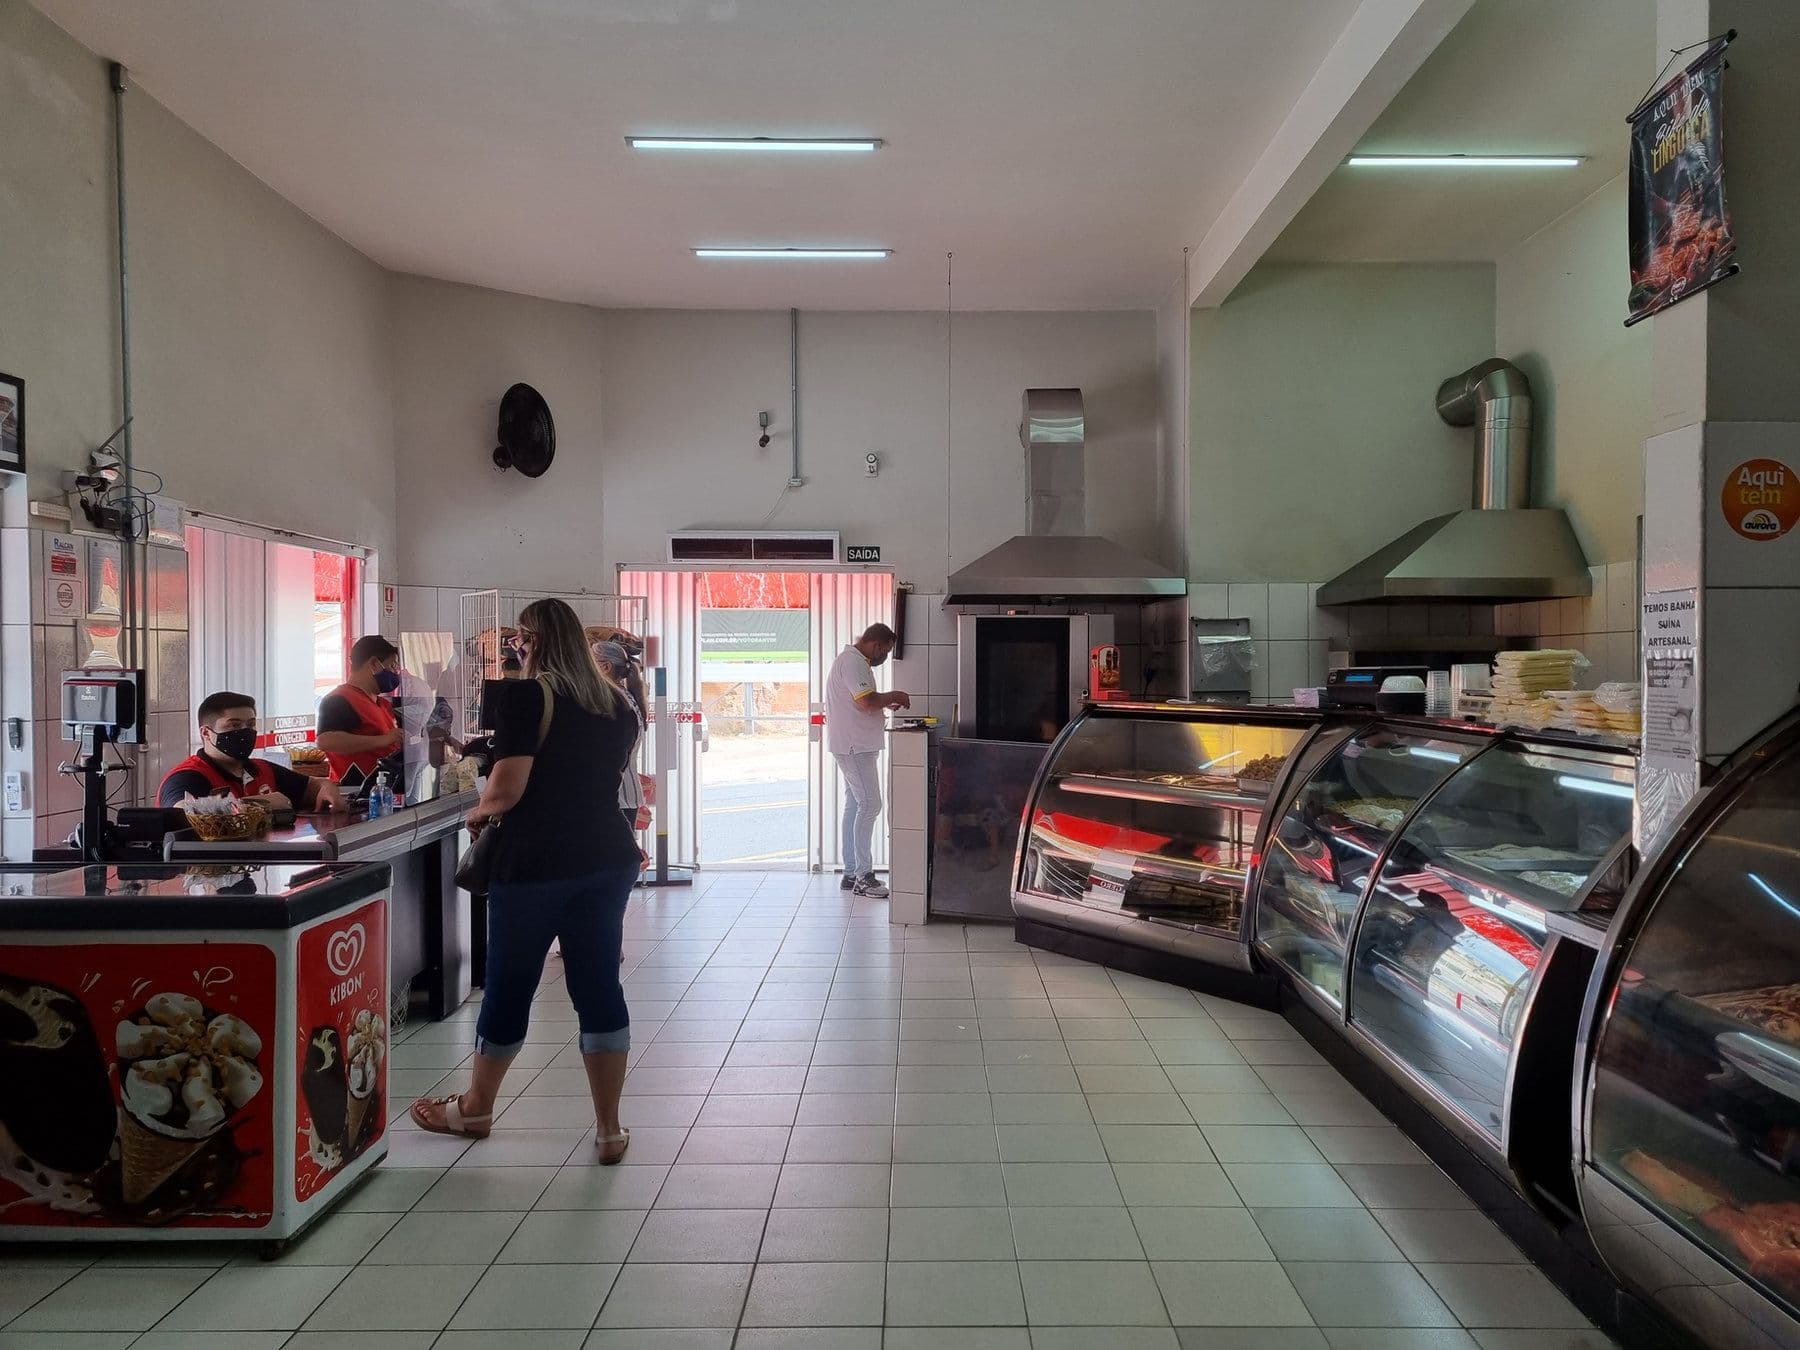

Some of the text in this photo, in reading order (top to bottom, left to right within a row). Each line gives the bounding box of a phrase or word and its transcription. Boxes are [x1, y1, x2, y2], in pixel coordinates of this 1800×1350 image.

[1690, 93, 1711, 118] de
[1737, 466, 1784, 491] Aqui
[1740, 486, 1781, 505] tem
[1744, 521, 1777, 530] aurora
[849, 548, 879, 559] SAÍDA
[1643, 600, 1695, 613] TEMOS BANHA
[1658, 617, 1681, 629] SUÍNA
[1648, 636, 1691, 647] ARTESANAL
[275, 731, 307, 745] CONEGERO
[331, 972, 362, 1006] KIBON
